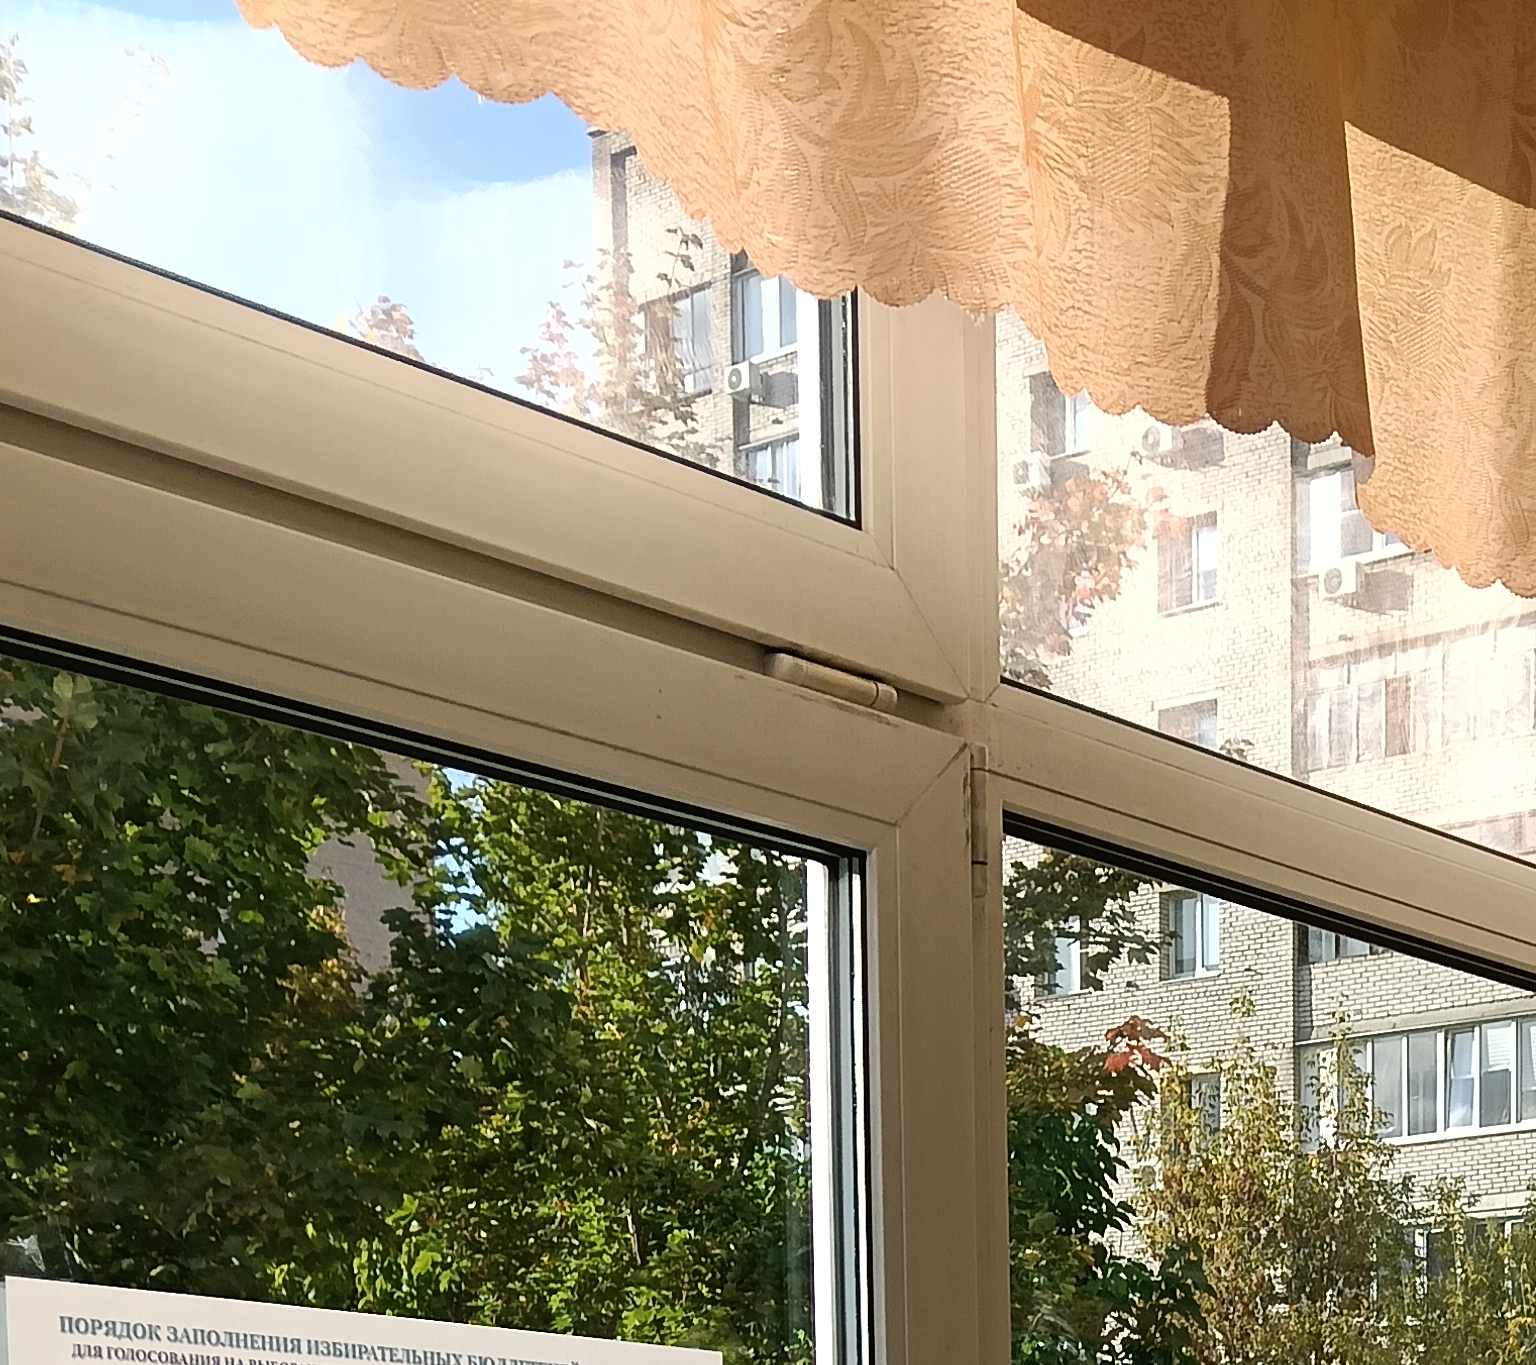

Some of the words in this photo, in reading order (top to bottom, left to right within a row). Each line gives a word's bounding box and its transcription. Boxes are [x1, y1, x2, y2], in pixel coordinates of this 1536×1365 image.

[60, 1316, 161, 1342] ПОРЯДОК
[167, 1326, 302, 1354] ЗАПОЛНЕНИЯ
[72, 1344, 103, 1359] ДЛЯ
